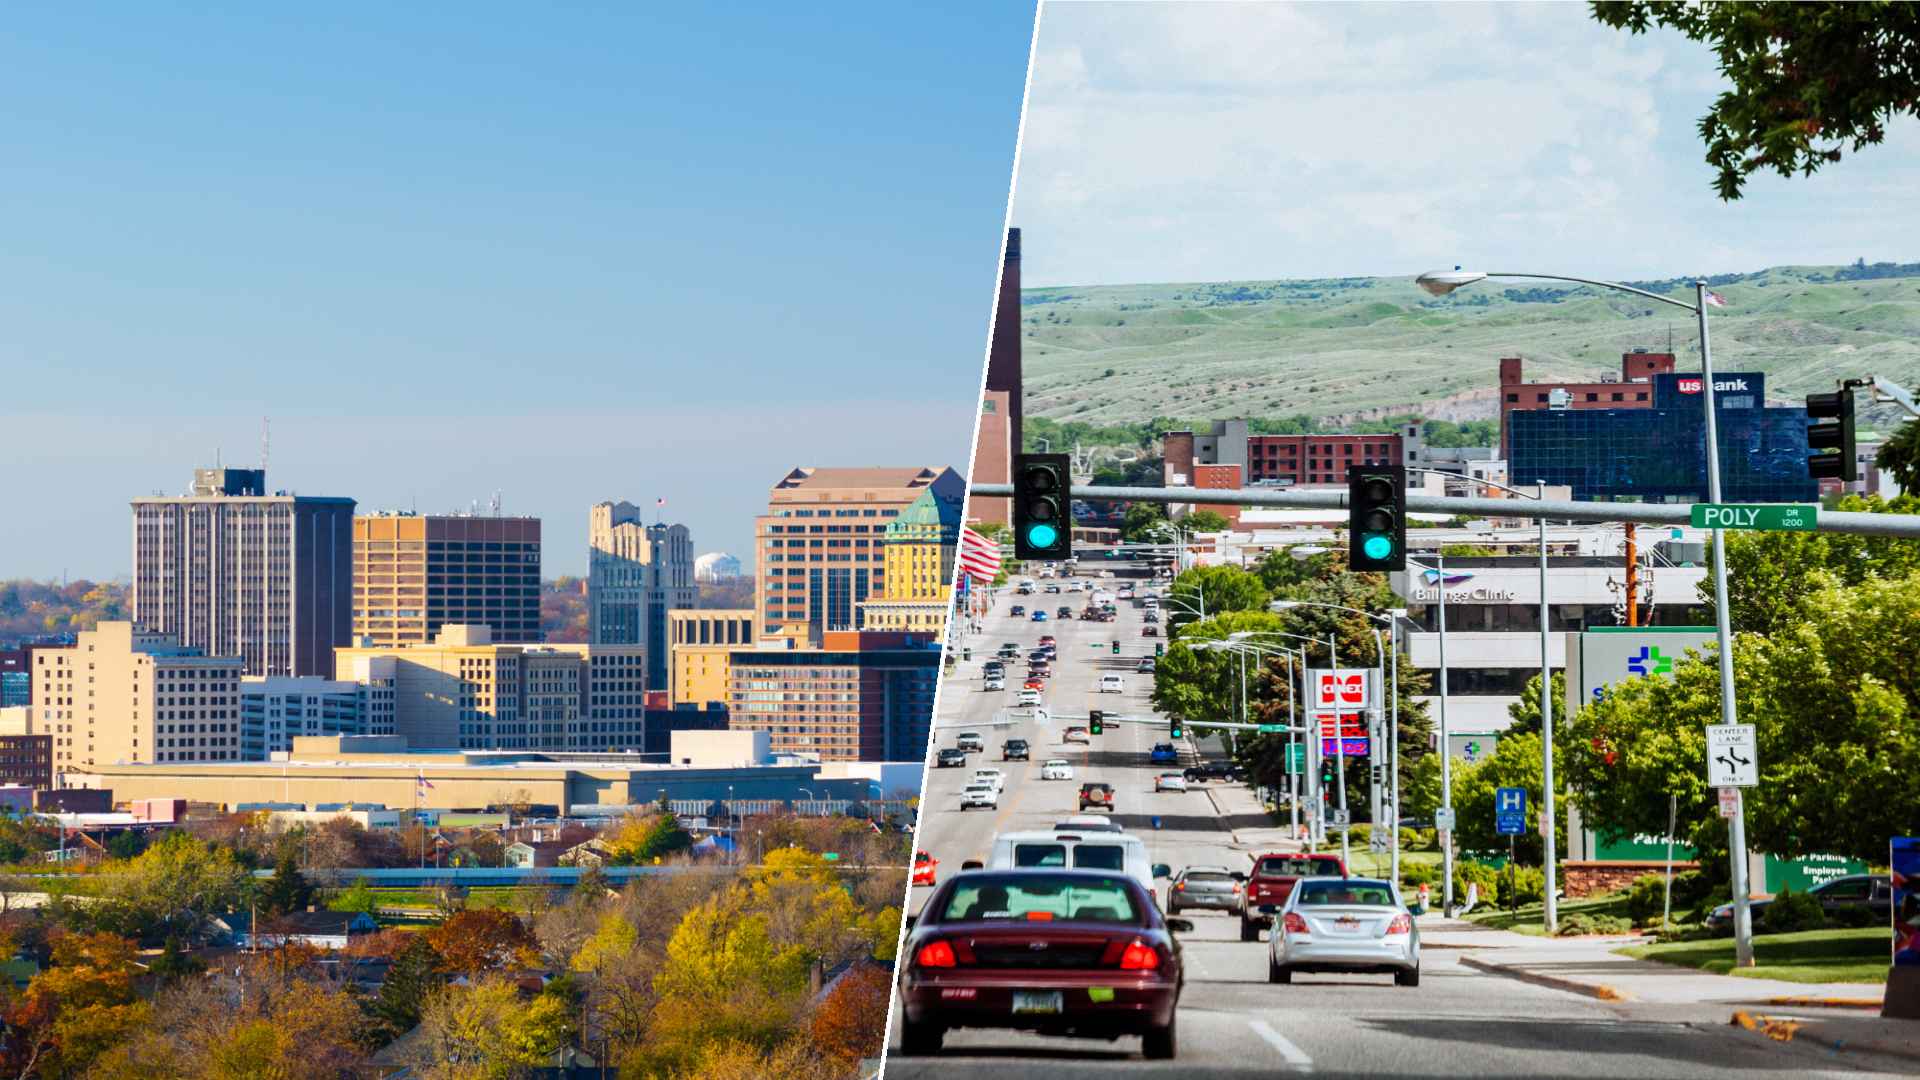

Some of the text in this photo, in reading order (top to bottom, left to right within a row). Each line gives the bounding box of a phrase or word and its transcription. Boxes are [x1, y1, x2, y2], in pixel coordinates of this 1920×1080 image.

[1703, 379, 1749, 391] ank
[1704, 508, 1760, 526] POLY
[1786, 509, 1799, 517] DR
[1782, 518, 1803, 527] 1200
[1416, 587, 1515, 603] Billngs Clinic
[1502, 791, 1520, 810] H
[1803, 866, 1847, 876] Employee
